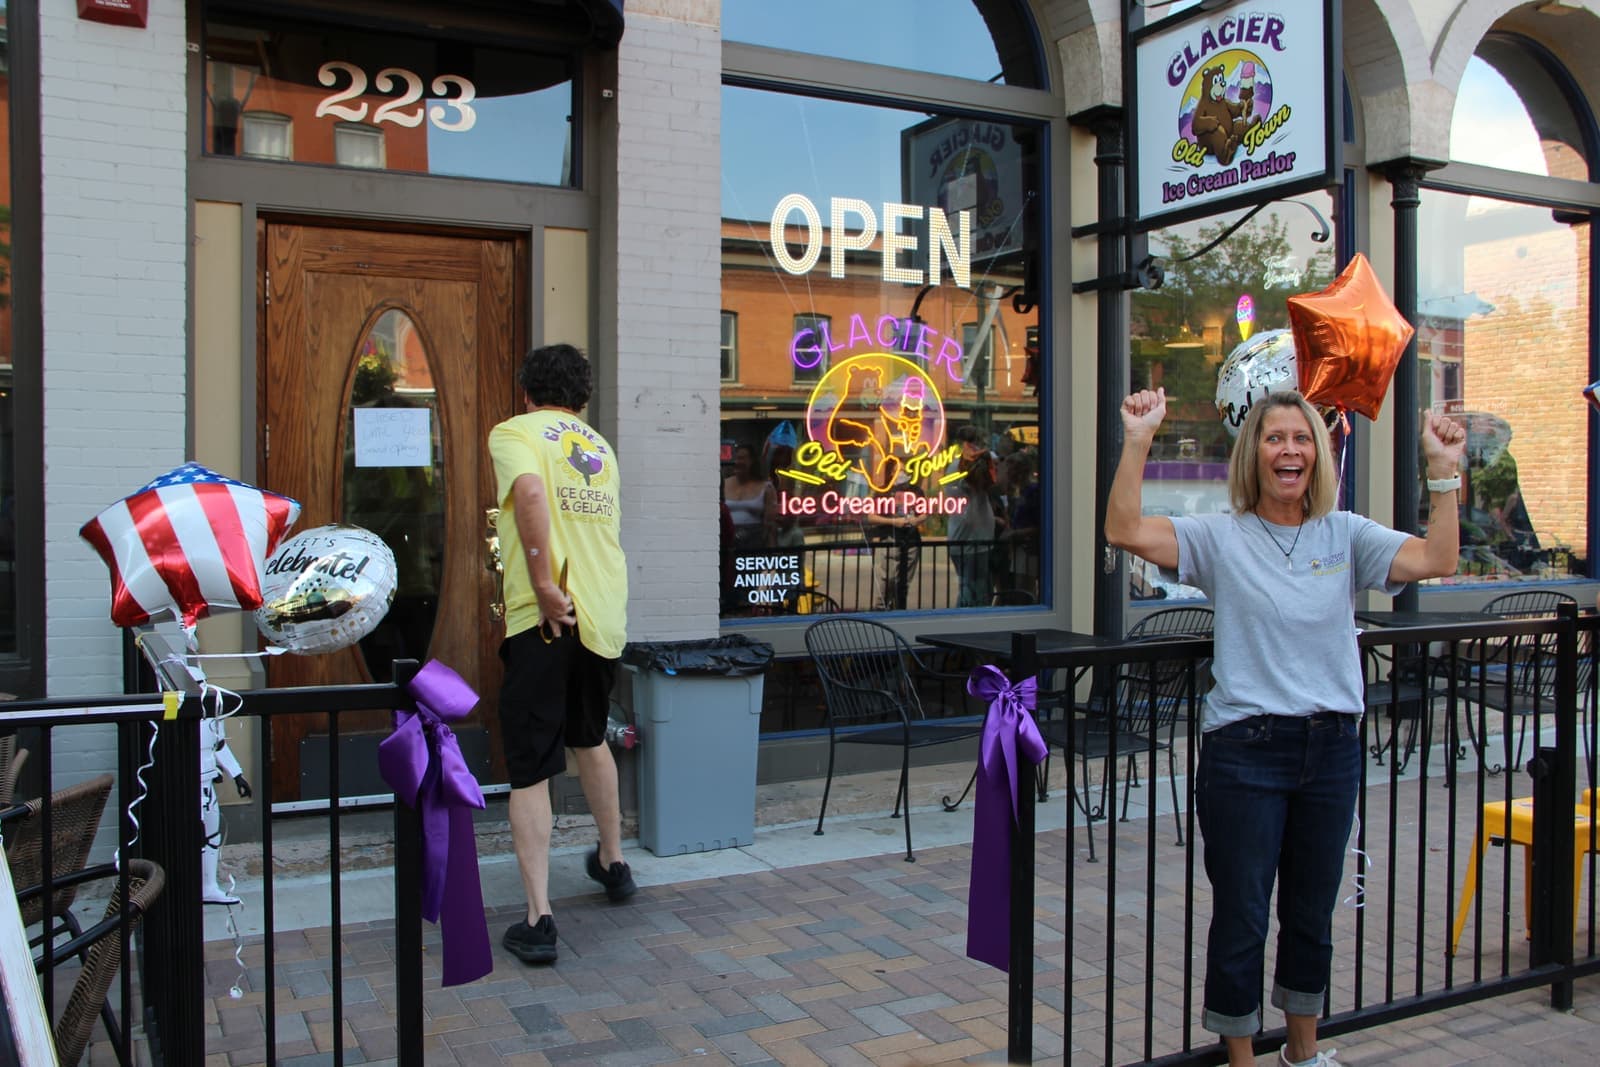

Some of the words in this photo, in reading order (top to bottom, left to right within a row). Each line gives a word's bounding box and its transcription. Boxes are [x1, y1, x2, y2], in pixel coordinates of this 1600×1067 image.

[1167, 11, 1286, 87] GLACIER
[315, 60, 477, 133] 223
[1172, 138, 1207, 167] Old
[1243, 103, 1291, 155] Town
[1162, 181, 1185, 203] Ice
[1187, 167, 1239, 194] Cream
[1239, 151, 1296, 184] Parlor
[770, 193, 971, 288] OPEN
[791, 314, 965, 382] GLACIER
[1249, 366, 1290, 390] LET'S
[797, 442, 852, 481] Old
[905, 444, 962, 485] Town
[556, 486, 577, 499] ICE
[579, 489, 614, 506] CREAM
[560, 499, 570, 511] &
[572, 500, 613, 517] GELATO
[781, 491, 816, 515] Ice
[821, 491, 896, 515] Cream
[903, 491, 967, 515] Parlor
[294, 537, 337, 548] LET'S
[265, 546, 370, 584] elebrate!
[735, 555, 799, 571] SERVICE
[734, 572, 800, 588] ANIMALS
[748, 589, 787, 604] ONLY
